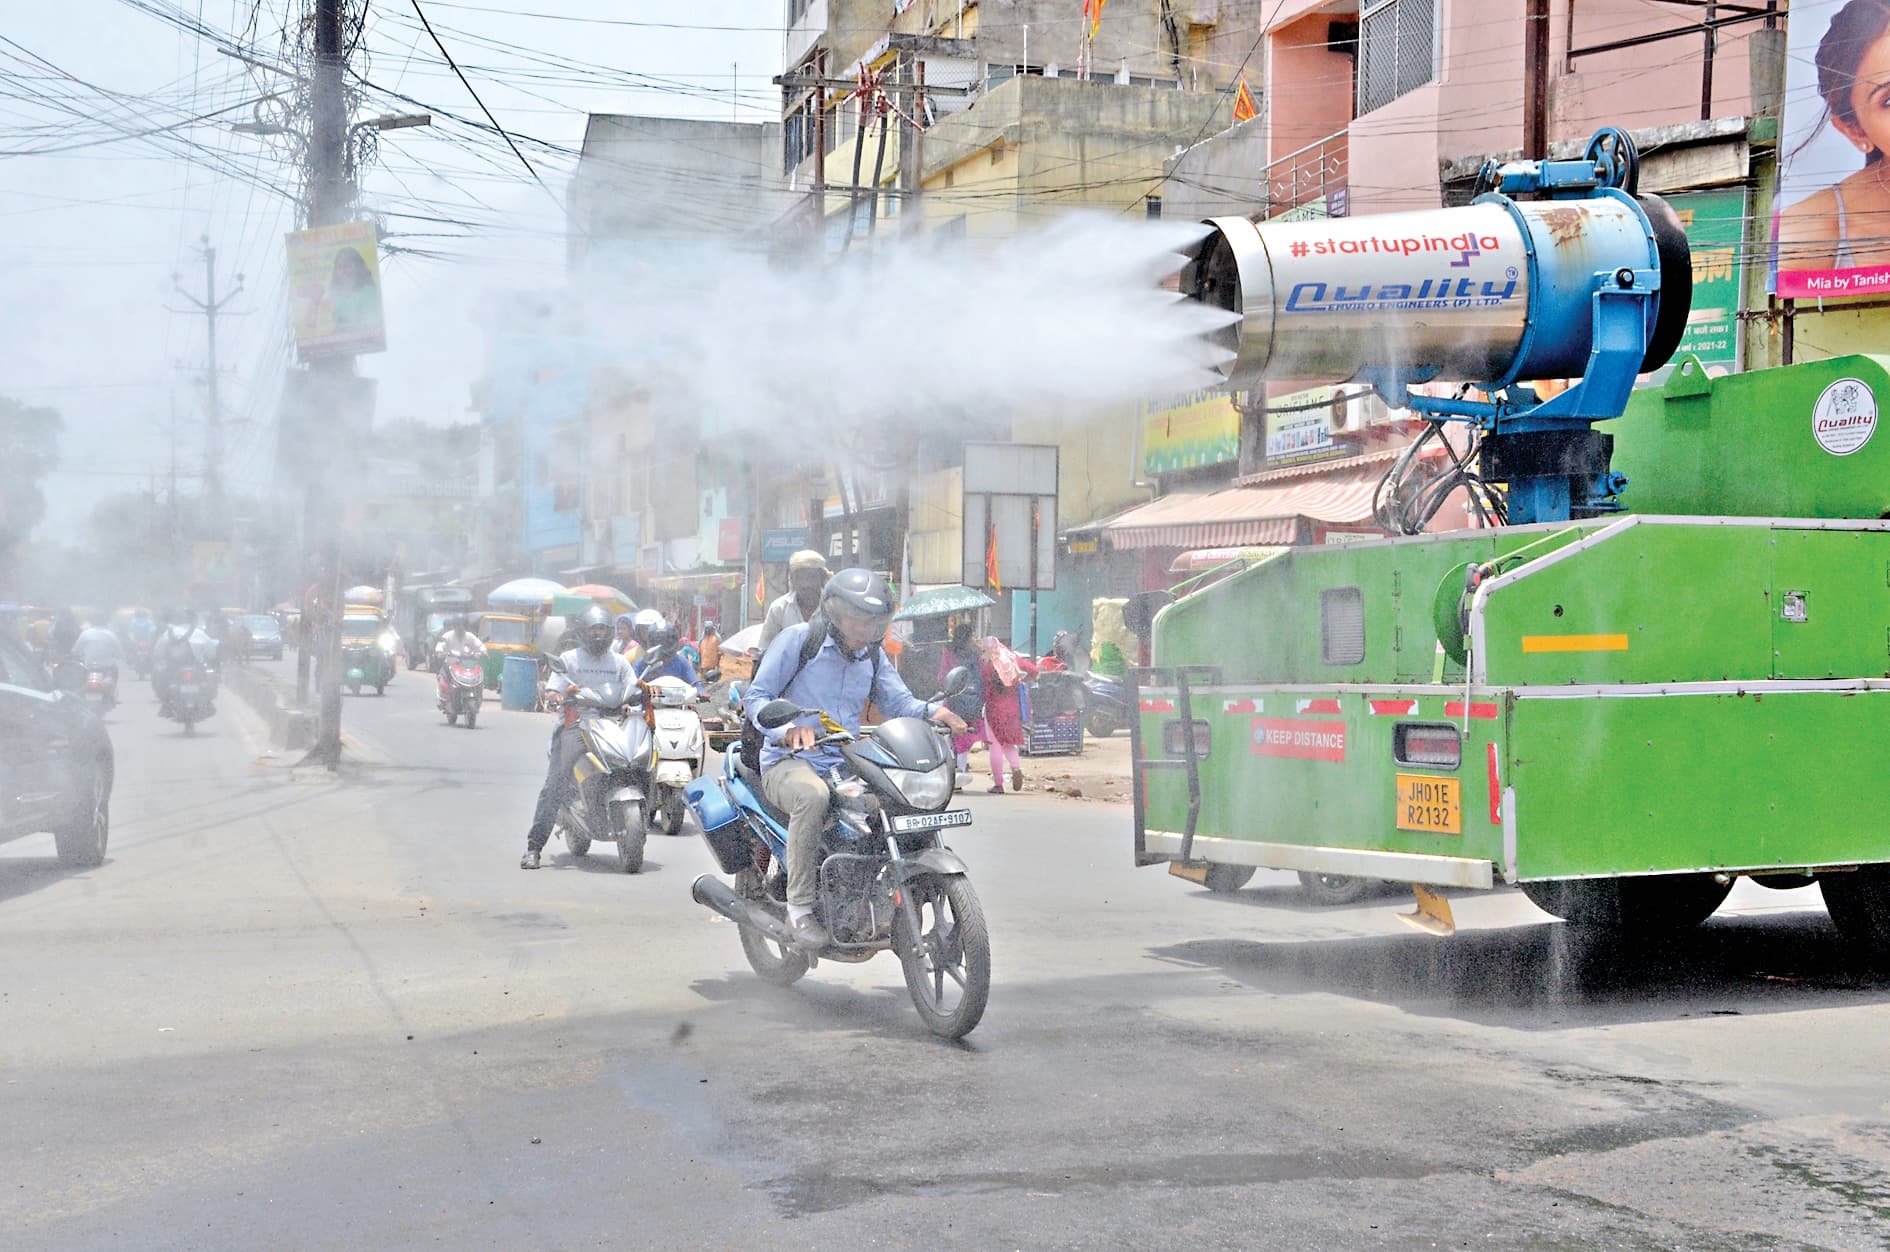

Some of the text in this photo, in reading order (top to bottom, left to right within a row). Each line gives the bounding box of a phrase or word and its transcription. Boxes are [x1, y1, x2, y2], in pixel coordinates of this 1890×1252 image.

[1290, 233, 1500, 266] #startupindia
[1807, 277, 1831, 289] Mia
[1834, 276, 1850, 290] by
[1285, 277, 1517, 312] Quality
[1328, 302, 1375, 312] ENVIRO
[1378, 300, 1448, 311] ENGINEERS
[1453, 299, 1471, 308] (P)
[1265, 729, 1344, 749] KEEP DISTANCE
[1408, 783, 1449, 804] JH01E
[1408, 805, 1449, 827] R2132
